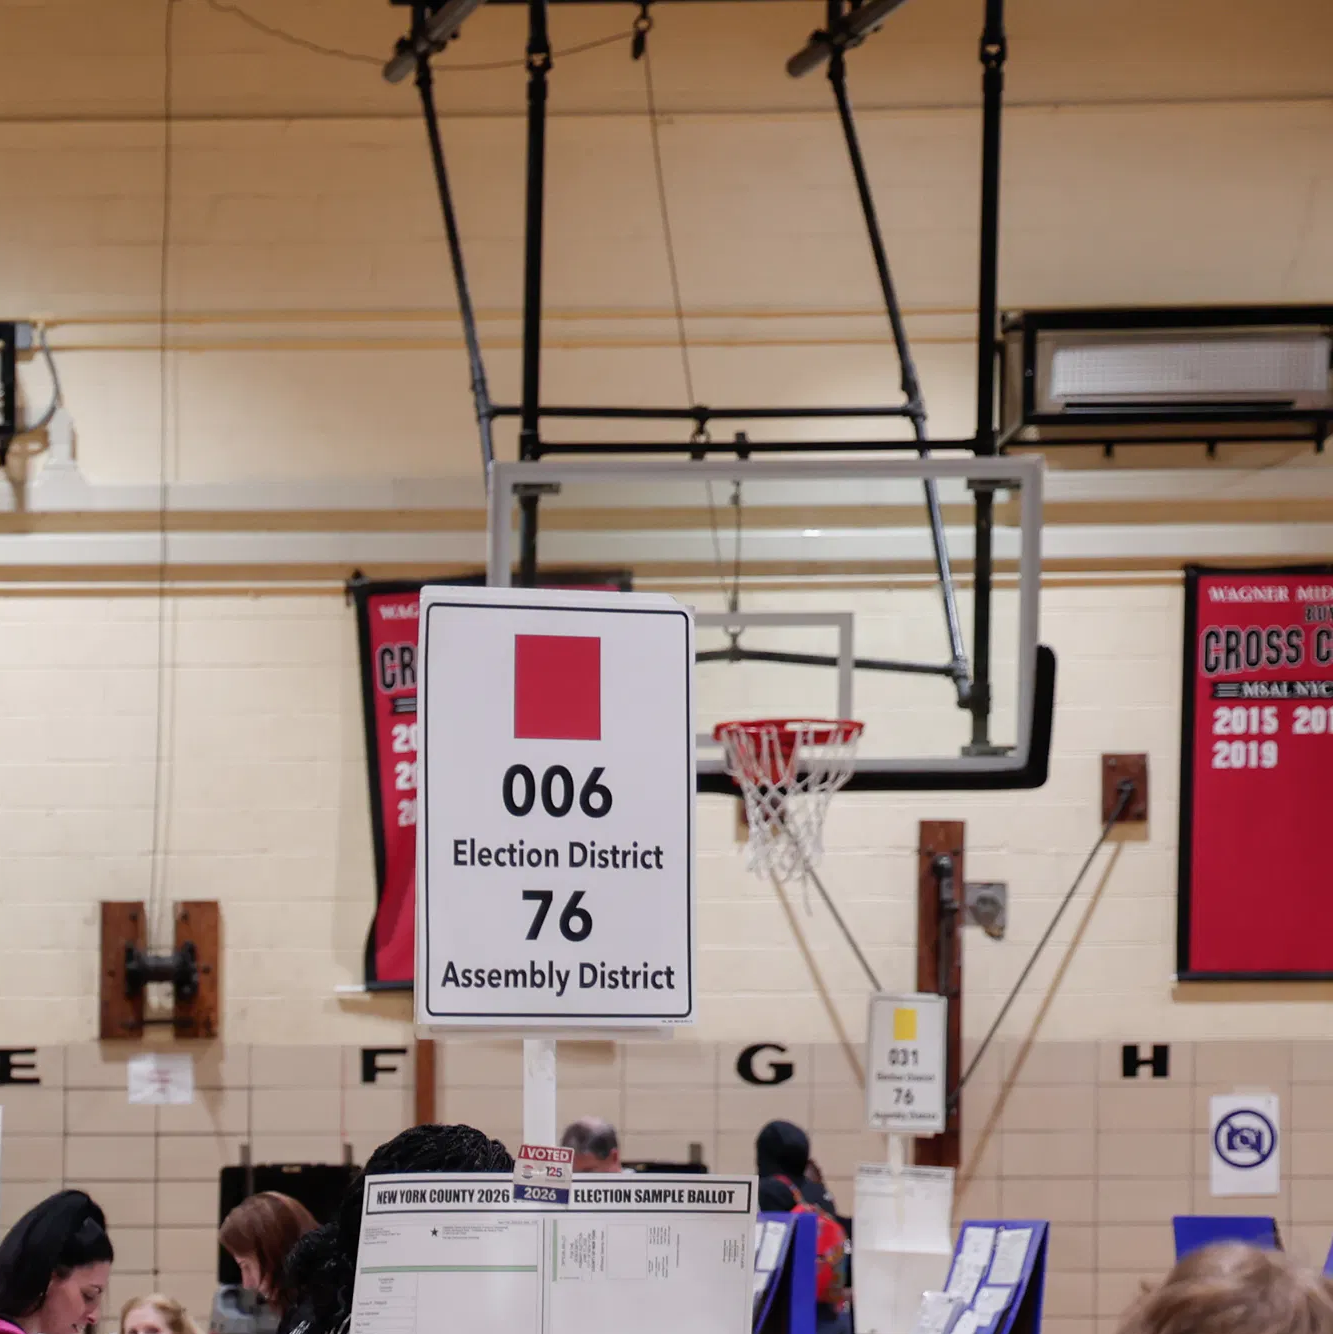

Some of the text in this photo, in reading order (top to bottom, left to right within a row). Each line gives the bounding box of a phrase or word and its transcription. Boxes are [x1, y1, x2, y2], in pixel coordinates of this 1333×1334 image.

[1208, 586, 1333, 602] WAGNER MID
[1200, 625, 1305, 678] CROSS
[1212, 705, 1279, 736] 2015
[1211, 740, 1279, 769] 2019
[502, 764, 613, 818] 006
[452, 838, 664, 870] Election District
[521, 890, 594, 942] 76
[441, 960, 675, 997] Assembly District
[361, 1047, 409, 1083] F
[735, 1044, 795, 1087] G
[888, 1048, 919, 1065] 031
[1122, 1043, 1169, 1078] H
[893, 1088, 915, 1105] 76
[520, 1145, 571, 1162] I VOTED
[376, 1188, 735, 1206] NEW YORK COUNTY 2026 ELECTION SAMPLE BALLOT
[524, 1187, 558, 1202] 2026
